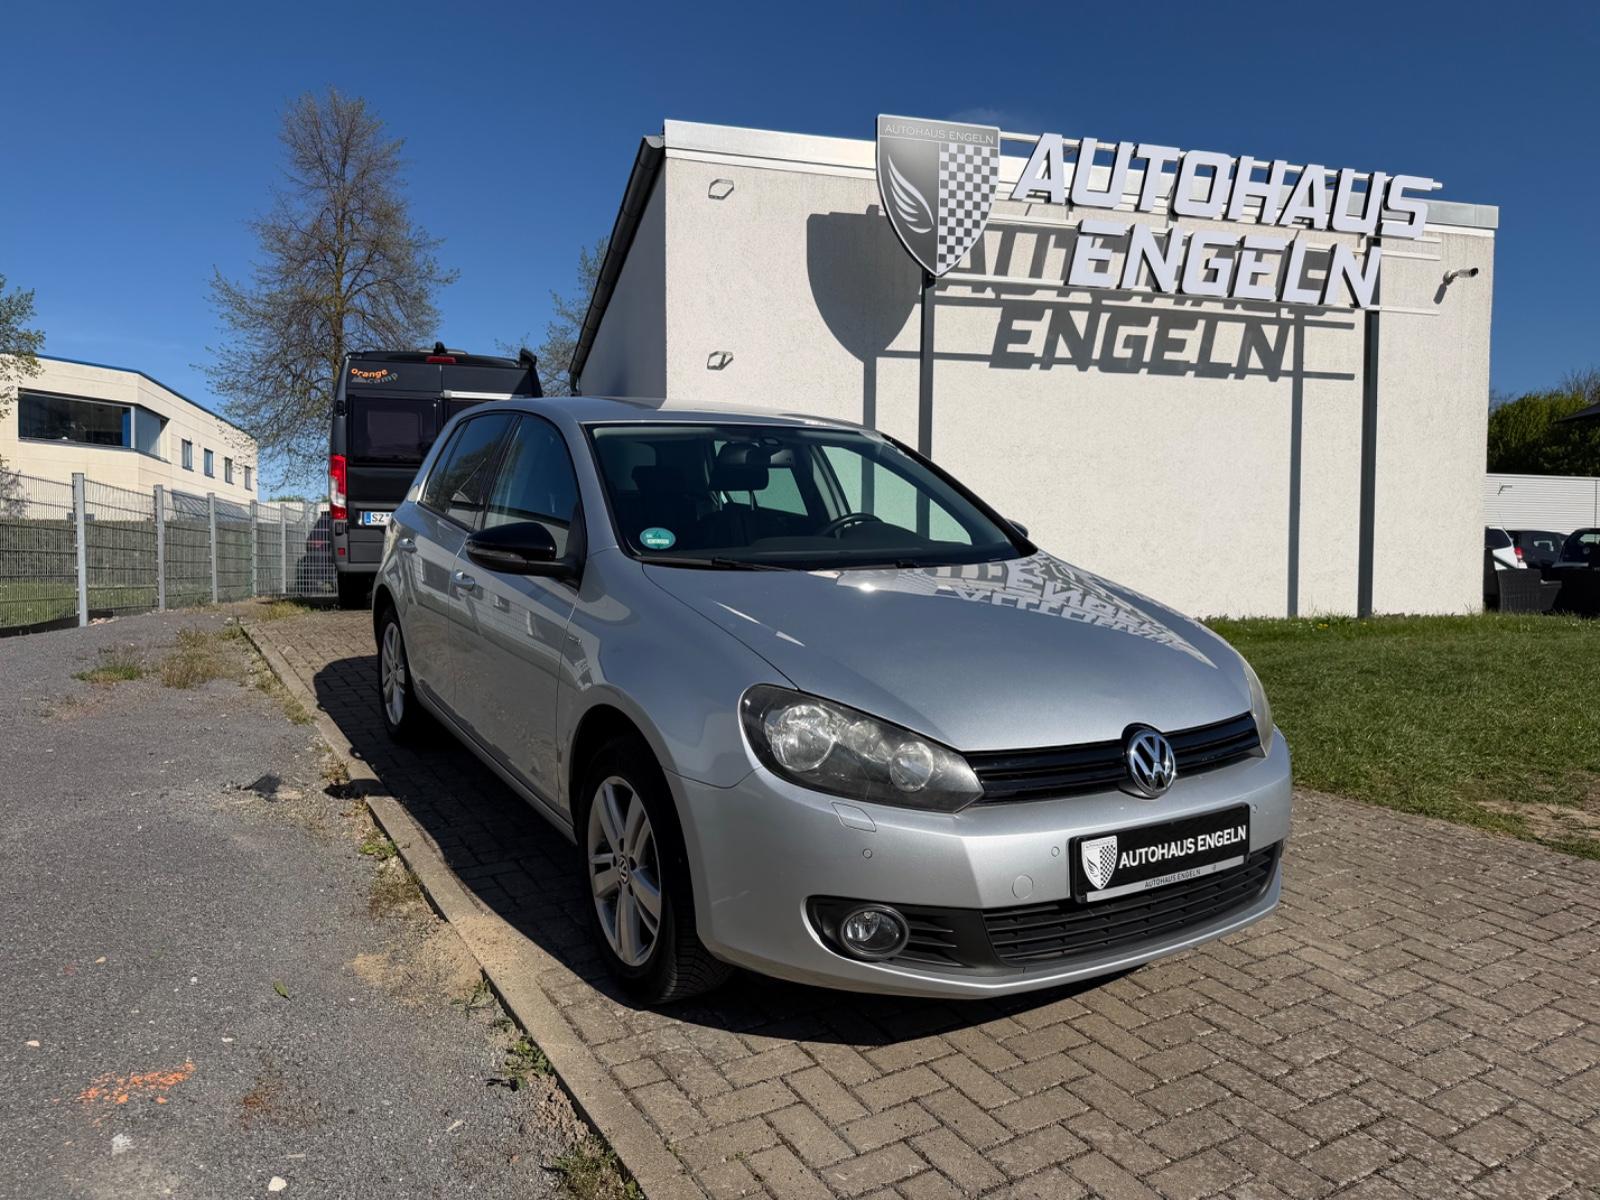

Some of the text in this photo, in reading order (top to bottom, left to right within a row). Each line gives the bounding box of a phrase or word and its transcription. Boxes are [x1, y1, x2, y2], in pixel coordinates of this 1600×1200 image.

[885, 124, 994, 144] AUTOHAUS ENGELN
[1011, 133, 1433, 239] AUTOHAUS
[1066, 218, 1382, 309] ENGELN
[351, 368, 388, 379] orange
[1118, 825, 1247, 869] AUTOHAUS ENGELN
[1144, 874, 1177, 889] AUTOHAUS
[1177, 868, 1201, 882] ENGELN
